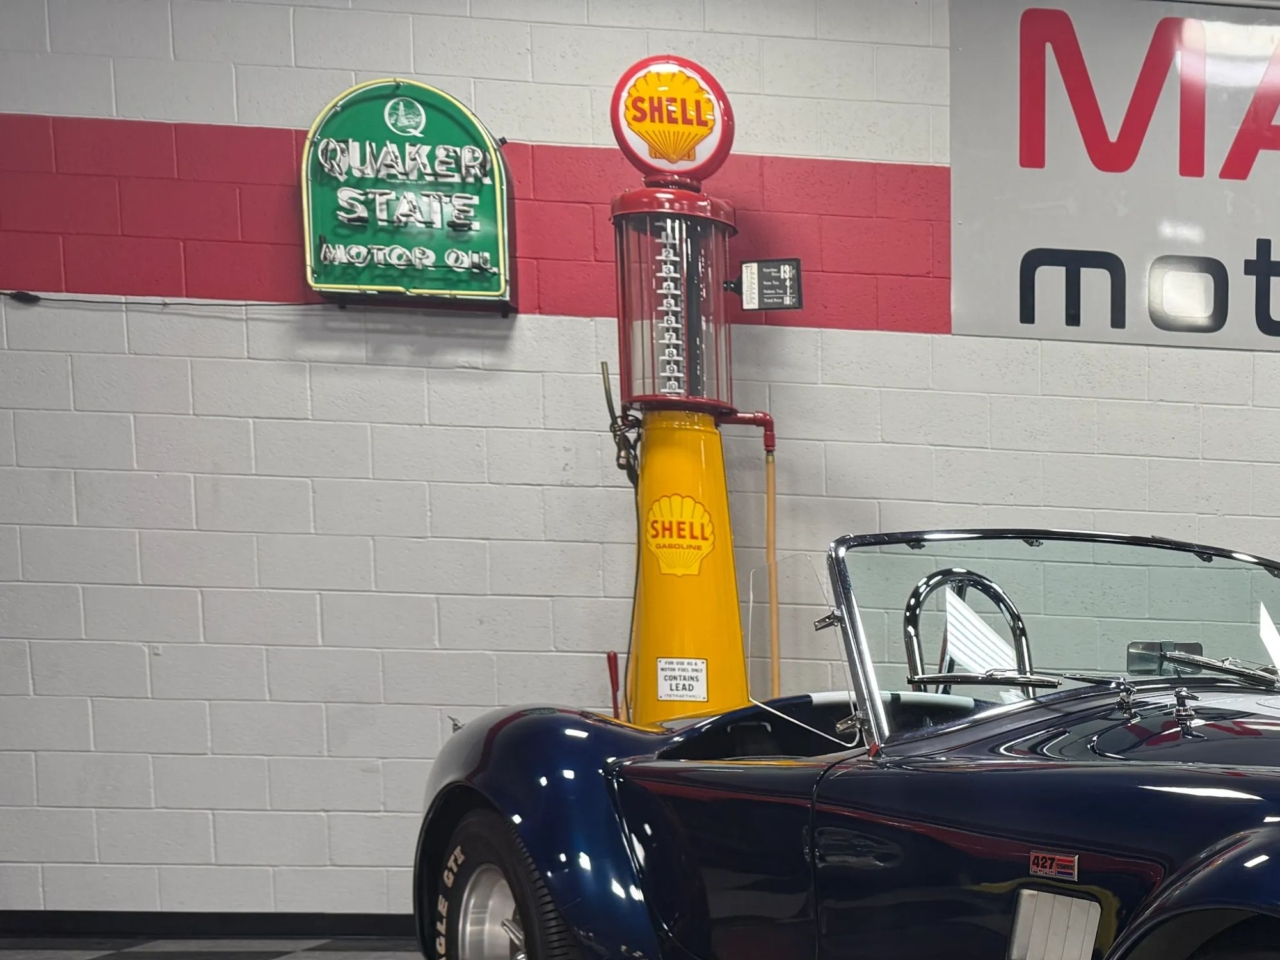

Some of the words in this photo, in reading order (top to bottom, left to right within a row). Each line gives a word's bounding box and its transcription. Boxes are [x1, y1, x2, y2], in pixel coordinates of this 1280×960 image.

[631, 95, 709, 127] SHELL
[318, 137, 493, 185] QUAKER
[337, 187, 481, 231] STATE
[320, 243, 437, 270] MOTOR
[444, 249, 498, 273] OIL
[664, 266, 671, 275] 3
[664, 283, 671, 291] 4
[665, 300, 672, 308] 5
[666, 316, 673, 325] 6
[667, 333, 674, 342] 7
[668, 349, 675, 358] 8
[668, 365, 675, 374] 9
[667, 382, 677, 391] 10
[650, 519, 709, 541] SHELL
[655, 543, 702, 551] GASOLINE
[663, 674, 700, 682] CONTAINS
[669, 682, 695, 692] LEAD
[1032, 855, 1056, 870] 427
